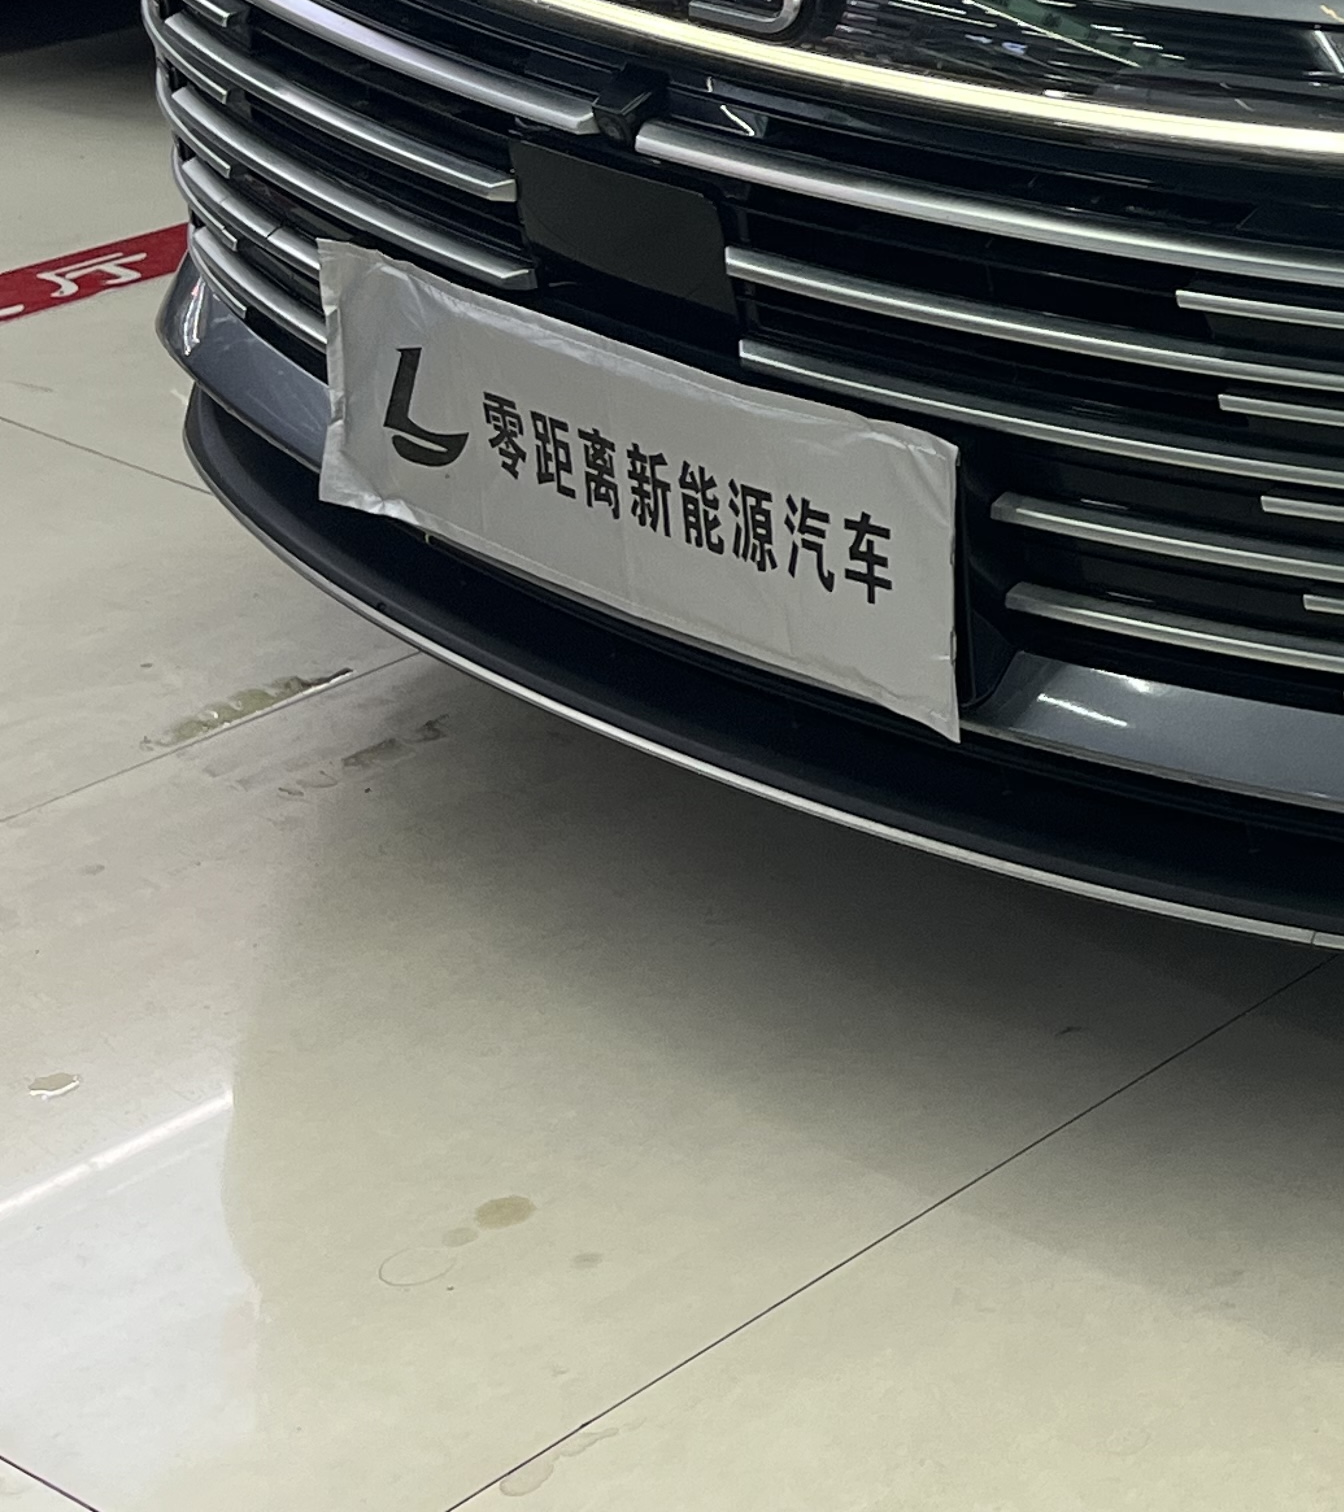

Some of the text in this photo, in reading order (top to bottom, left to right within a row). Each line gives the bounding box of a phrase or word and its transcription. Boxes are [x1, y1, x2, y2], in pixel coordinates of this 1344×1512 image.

[482, 390, 893, 605] 零距离新能源汽车
